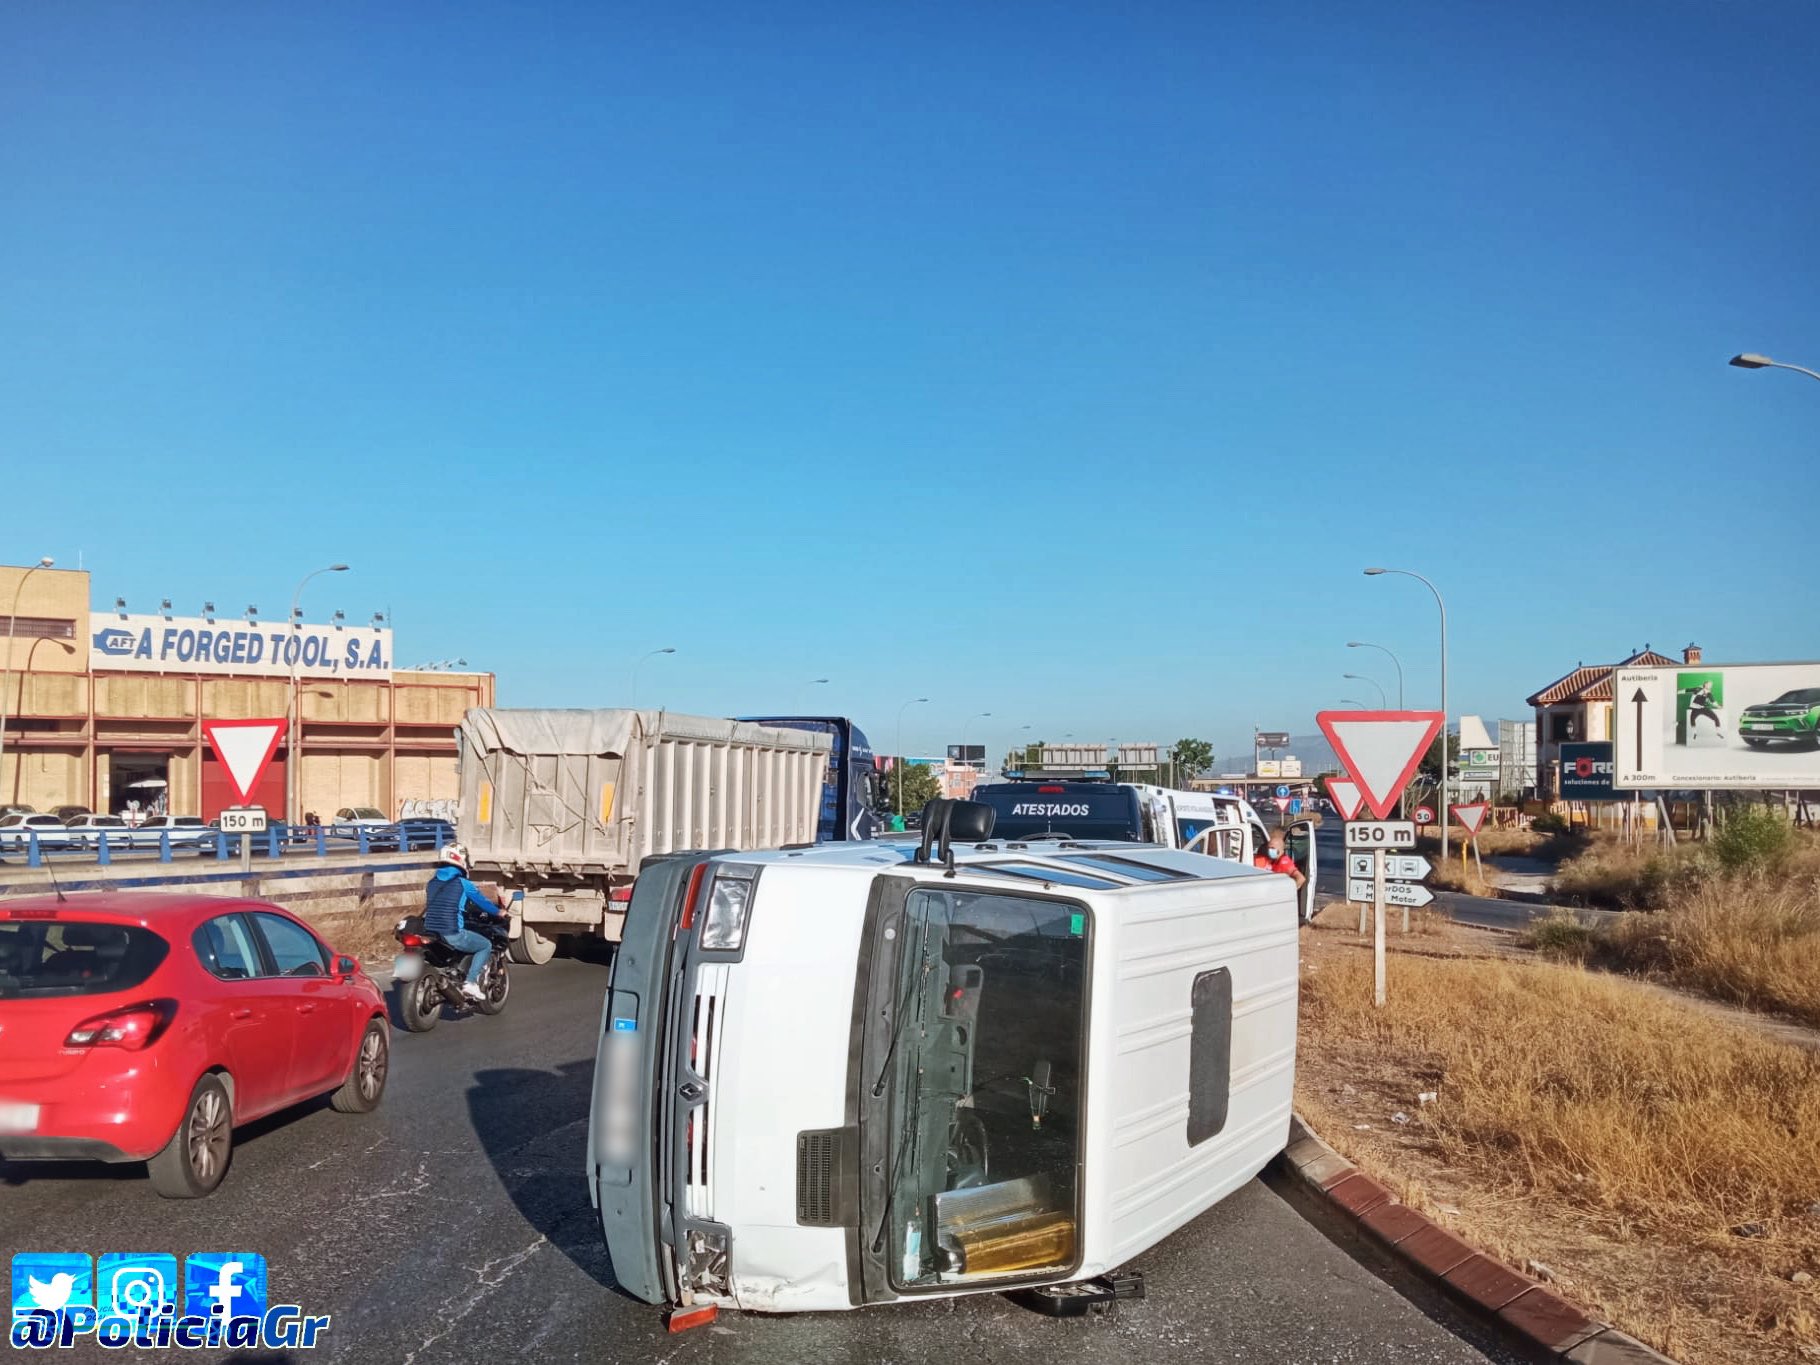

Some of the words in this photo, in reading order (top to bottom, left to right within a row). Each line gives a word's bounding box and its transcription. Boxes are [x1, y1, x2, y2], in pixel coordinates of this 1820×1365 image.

[134, 627, 152, 659] A
[160, 628, 263, 664] FORGED
[344, 638, 389, 669] S.A.
[1012, 803, 1090, 816] ATESTADOS
[223, 816, 246, 827] 150
[252, 818, 264, 827] m
[1349, 827, 1385, 842] 150
[1394, 830, 1411, 841] m
[1391, 895, 1417, 903] Motor
